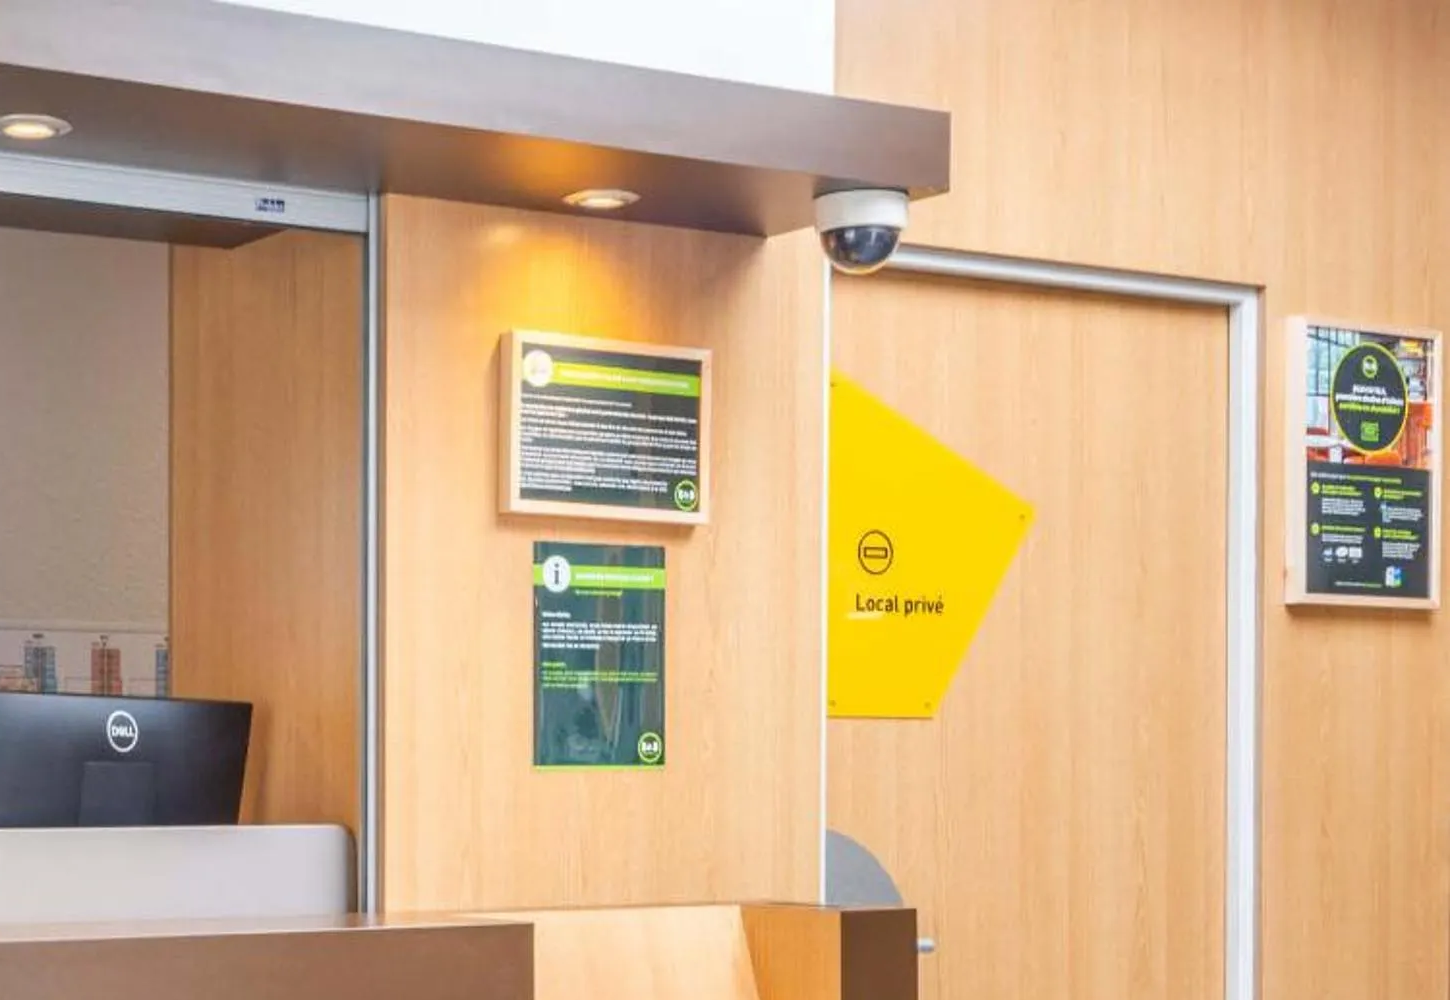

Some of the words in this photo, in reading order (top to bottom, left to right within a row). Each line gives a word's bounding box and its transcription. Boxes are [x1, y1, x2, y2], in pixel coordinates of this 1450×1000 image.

[856, 593, 899, 613] Local
[904, 595, 944, 617] privé
[111, 726, 134, 738] DELL
